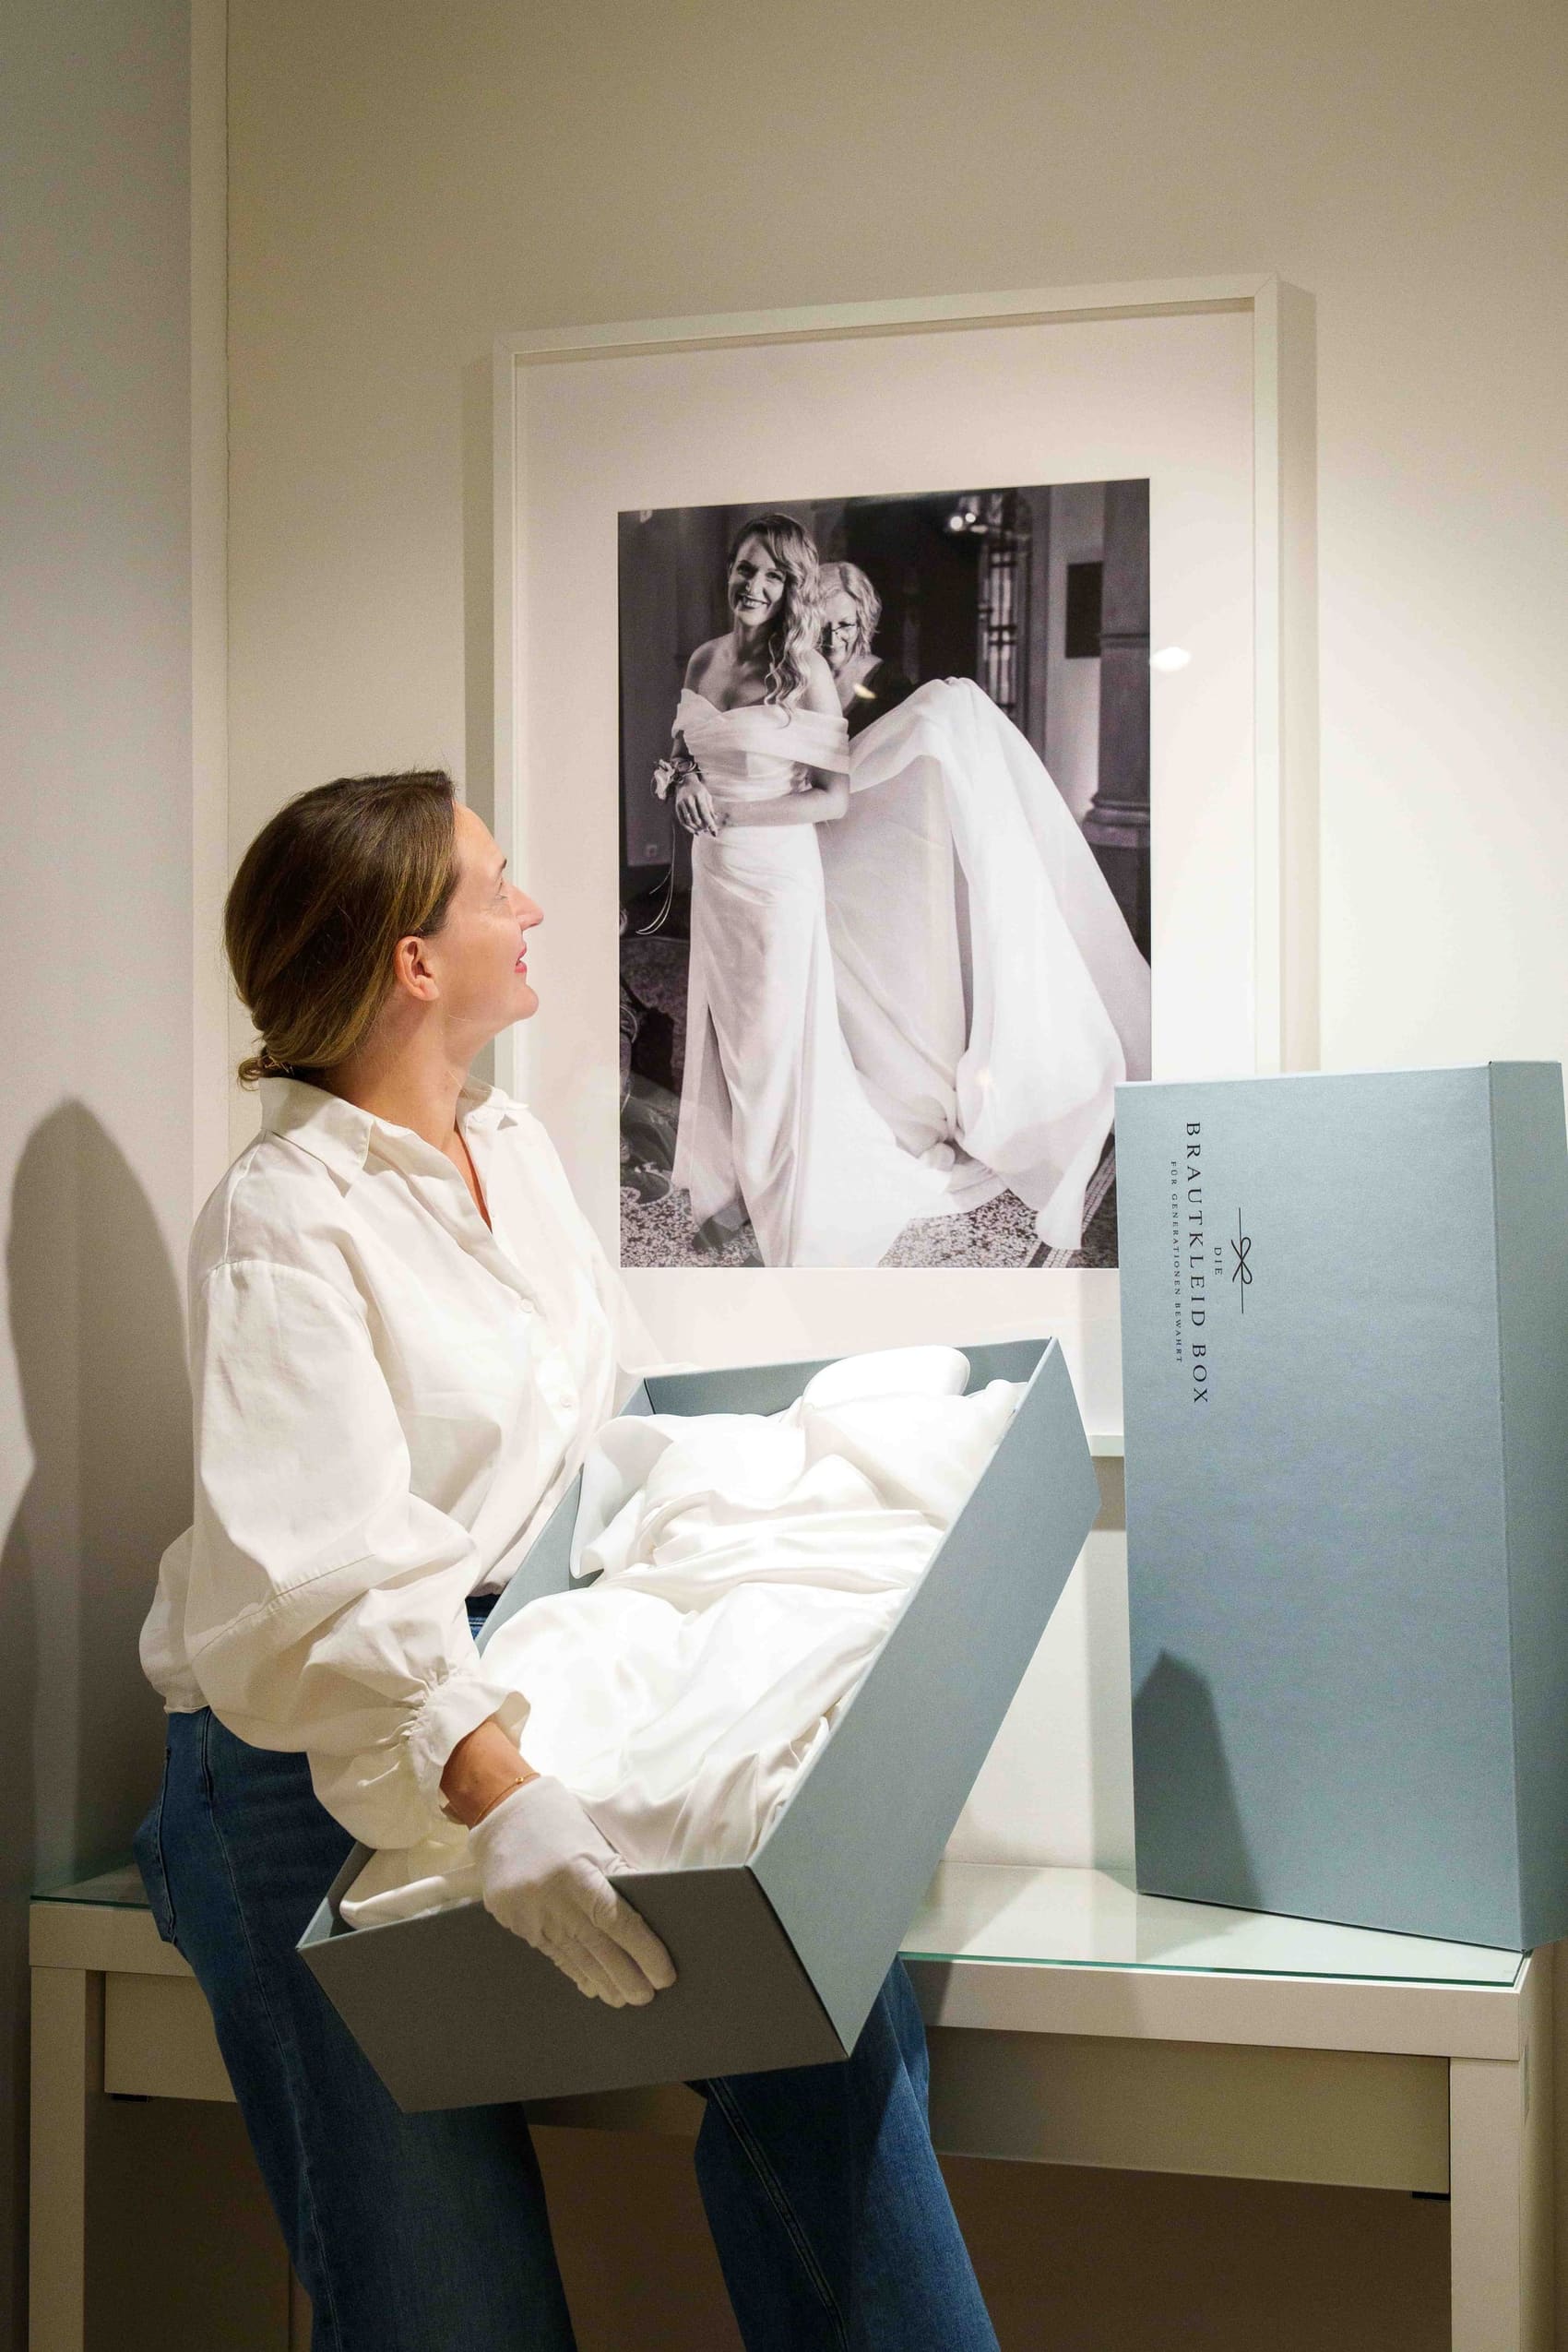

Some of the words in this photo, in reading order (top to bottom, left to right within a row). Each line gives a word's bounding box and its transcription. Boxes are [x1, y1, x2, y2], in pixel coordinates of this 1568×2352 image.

[1171, 1194, 1181, 1295] GENERATIONEN
[1186, 1122, 1206, 1326] BRAUTKLEID
[1214, 1247, 1222, 1276] DIE
[1174, 1302, 1182, 1363] BEWAHRT
[1192, 1342, 1208, 1403] BOX
